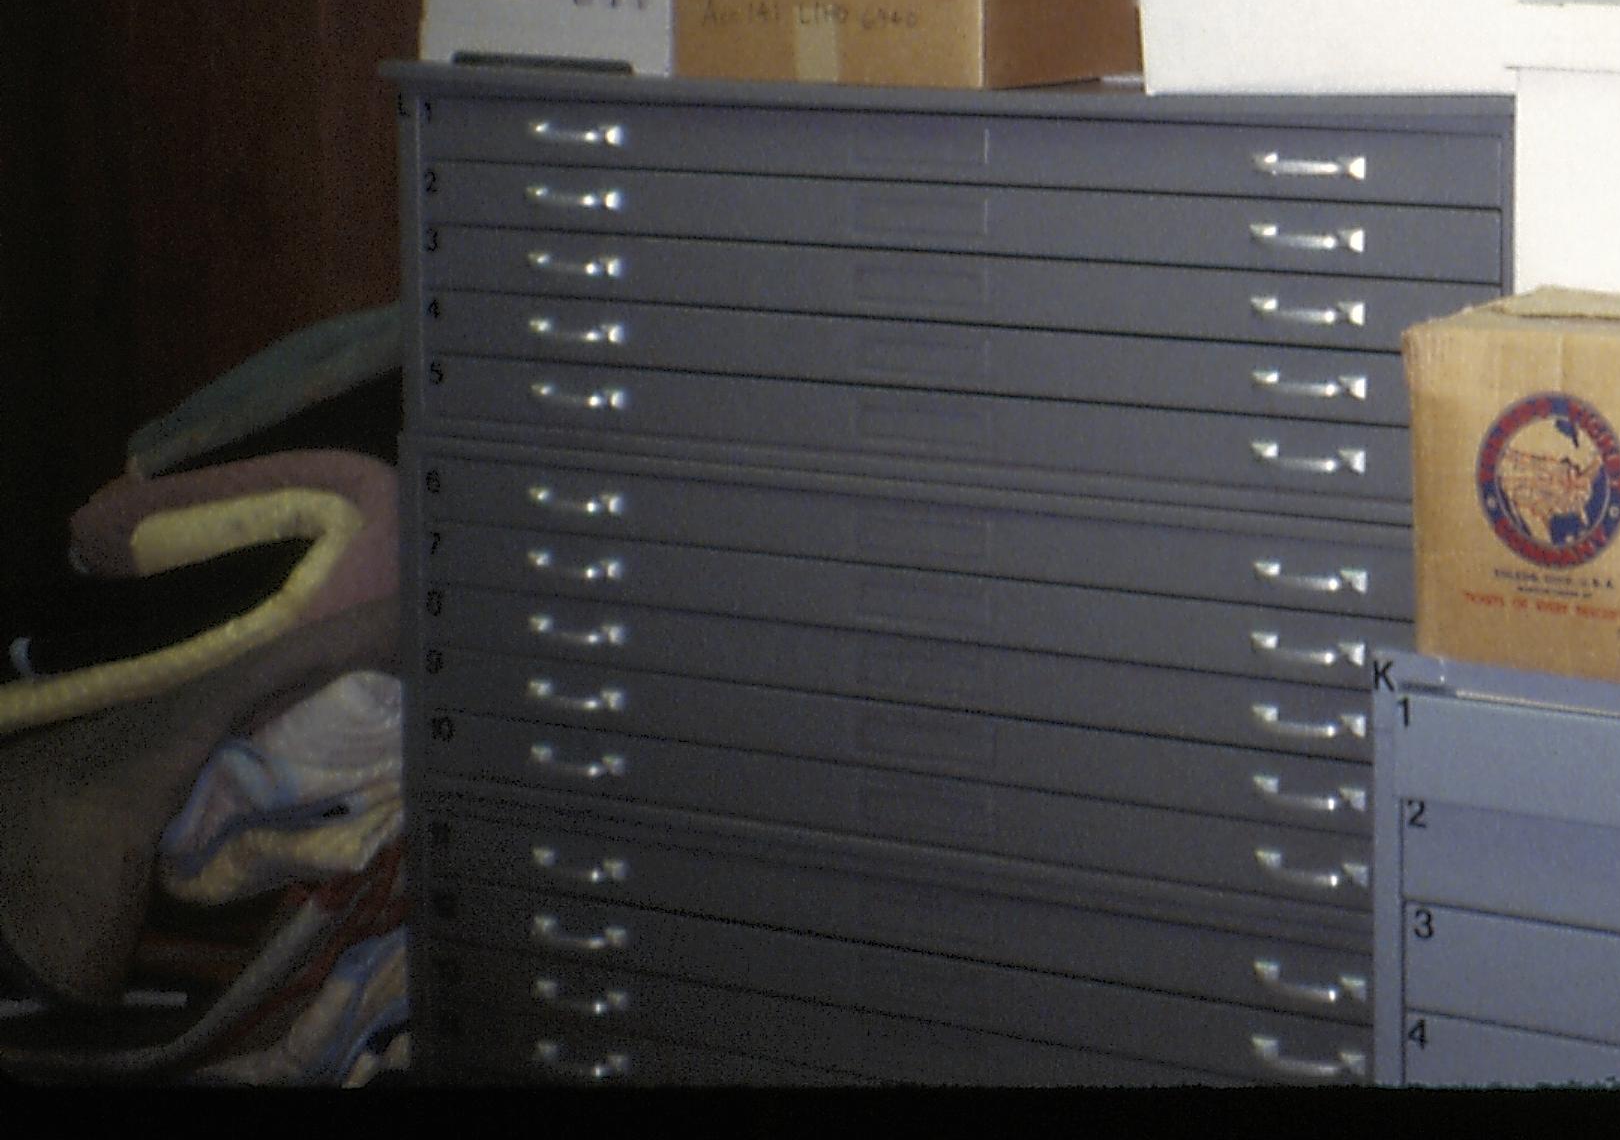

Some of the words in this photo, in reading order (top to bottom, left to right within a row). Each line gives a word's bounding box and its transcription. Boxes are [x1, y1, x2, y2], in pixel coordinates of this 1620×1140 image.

[423, 168, 438, 196] 2
[429, 361, 444, 387] 5
[1373, 660, 1395, 692] K
[1397, 697, 1411, 729] 1
[1407, 799, 1427, 830] 2
[1412, 908, 1435, 941] 3
[1408, 1018, 1428, 1051] 4
